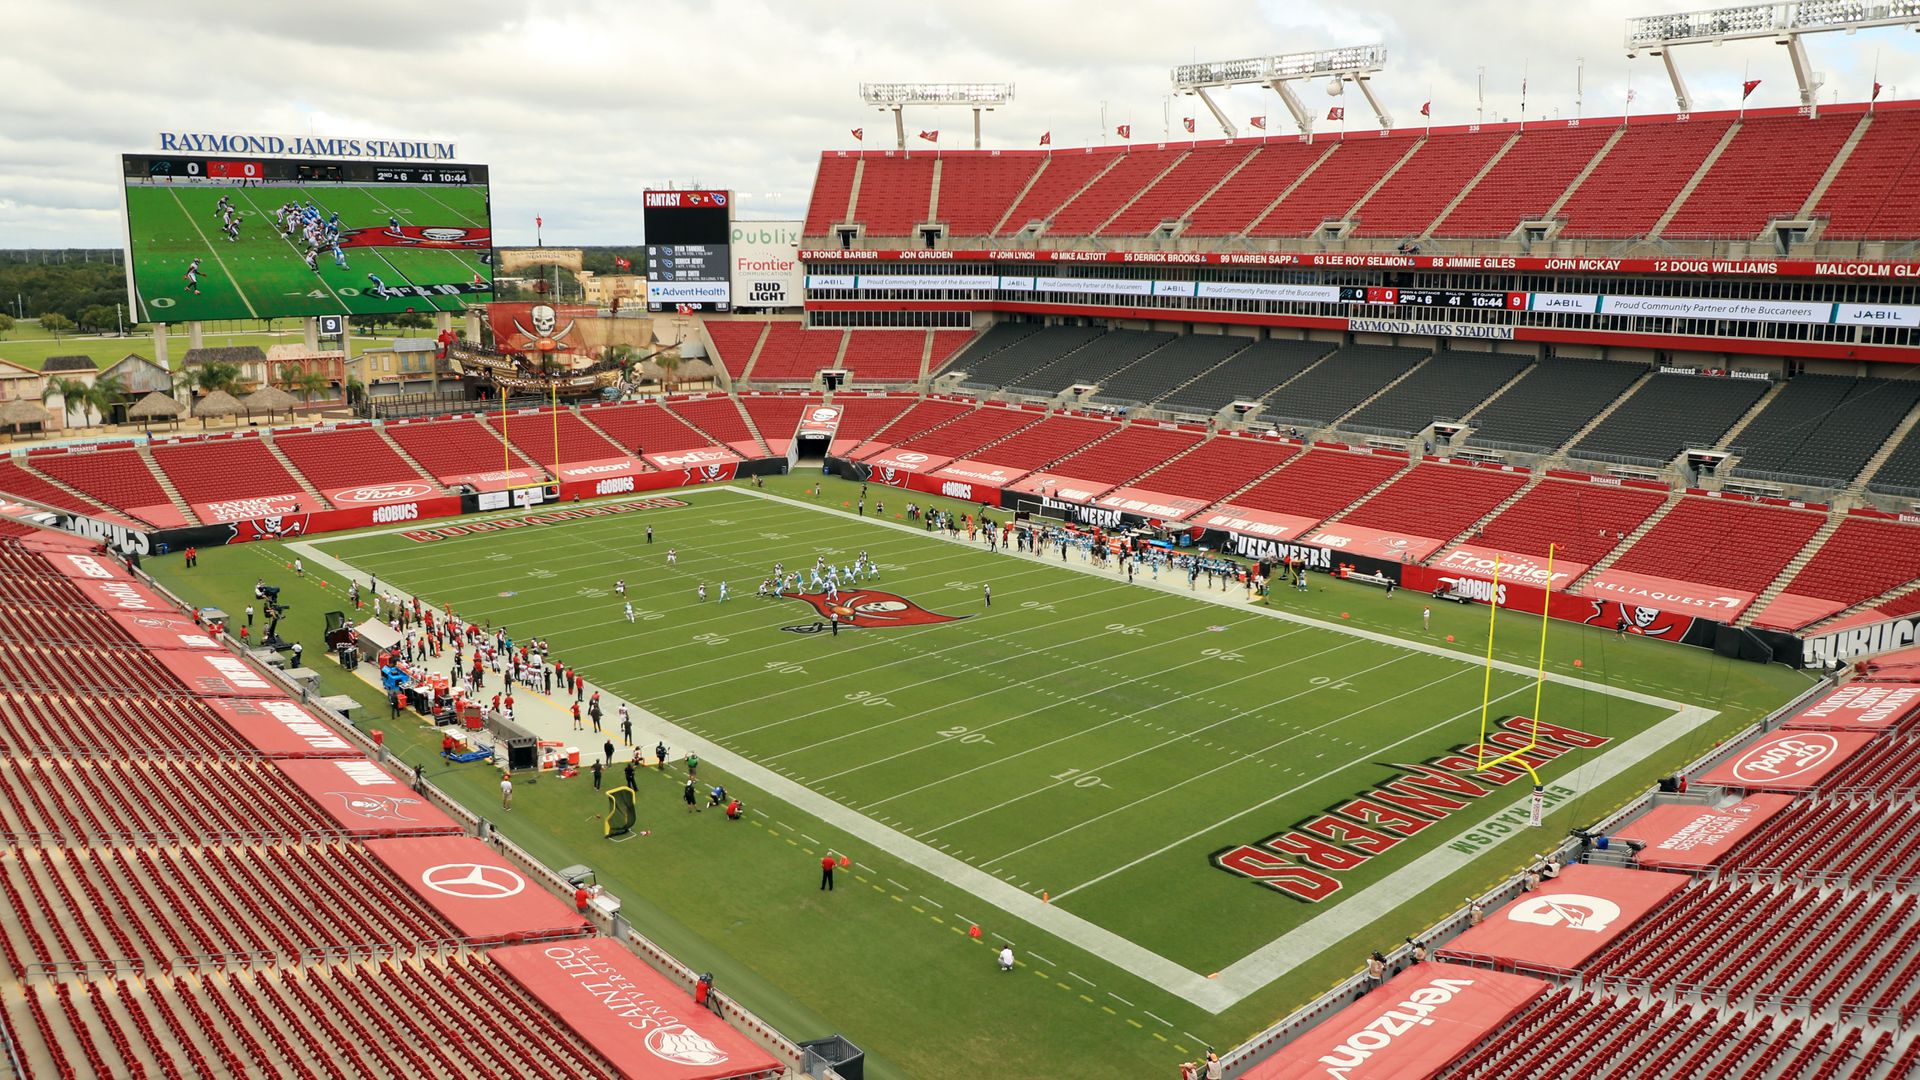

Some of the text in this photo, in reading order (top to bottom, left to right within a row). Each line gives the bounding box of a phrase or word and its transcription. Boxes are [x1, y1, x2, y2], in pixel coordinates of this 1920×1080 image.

[160, 132, 455, 160] RAYMOND JAMES STADIUM
[187, 162, 199, 175] 0
[244, 164, 256, 176] 0
[378, 172, 392, 180] 2ND
[400, 173, 408, 181] 6
[422, 174, 432, 182] 41
[439, 174, 468, 182] 10:44
[646, 193, 682, 206] FANTASY
[731, 228, 797, 245] Publix
[813, 250, 842, 259] RONDÉ
[1015, 252, 1036, 260] LYNCH
[1059, 252, 1078, 260] MIKE
[1078, 252, 1107, 262] ALSTOTT
[1124, 253, 1200, 262] 55 DERRICK BROOKS
[1220, 254, 1292, 264] 99 WARREN SAPP
[1314, 256, 1407, 266] 63 LEE ROY SELMON
[738, 258, 794, 270] Frontier
[1432, 258, 1516, 268] 88 JIMMIE GILES
[1545, 260, 1620, 272] JOHN MCKAY
[1654, 262, 1778, 274] 12 DOUG WILLIAMS
[1815, 264, 1890, 276] MALCOLM
[434, 284, 460, 295] 10
[754, 282, 780, 292] BUD
[884, 279, 913, 288] Community
[1055, 281, 1082, 289] Community
[662, 288, 726, 296] AdventHealth
[750, 292, 786, 301] LIGHT
[1222, 286, 1254, 296] Community
[1355, 289, 1363, 298] 0
[1385, 290, 1392, 300] 0
[1400, 295, 1416, 303] 2ND
[1425, 296, 1432, 304] 6
[1449, 296, 1460, 305] 41
[1472, 297, 1504, 307] 10:44
[1512, 297, 1520, 306] 9
[1546, 300, 1582, 308] JABIL
[1614, 301, 1812, 316] Proud Community Partner of the Buccaneers
[1854, 310, 1902, 320] JABIL
[326, 319, 336, 330] 9
[1350, 320, 1512, 339] RAYMOND JAMES STADIUM
[1660, 366, 1696, 375] BUCCANEERS
[1731, 370, 1768, 380] BUCCANEERS
[653, 452, 731, 466] FedEx
[564, 462, 630, 476] verizon
[942, 468, 1008, 482] AdventHealth
[596, 476, 634, 495] #GOBUCS
[1591, 476, 1620, 486] BUCCANEERS
[354, 486, 416, 500] Ford
[942, 480, 972, 500] #GOBUCS
[208, 494, 296, 510] RAYMOND
[214, 502, 271, 516] JAMES
[1102, 496, 1124, 506] ALL
[1124, 500, 1148, 510] OUR
[216, 504, 296, 522] STADIUM
[372, 503, 418, 523] #GOBUCS
[400, 497, 689, 543] BUCCANEERS
[1208, 516, 1288, 536] ON THE FRONT
[1310, 534, 1352, 548] LINES
[1444, 550, 1568, 581] Frontier
[1440, 561, 1550, 586] COMMUNICATIONS
[1594, 582, 1719, 608] RELIAQUEST
[692, 632, 730, 646] 50
[766, 660, 802, 674] 40
[844, 690, 889, 707] 30
[1802, 686, 1867, 717] STADIUM
[1846, 688, 1894, 708] JAMES
[1857, 688, 1920, 722] RAYMOND
[936, 726, 986, 745] 20
[1745, 740, 1826, 774] Ford
[1050, 768, 1102, 789] 10
[1212, 714, 1615, 902] BUCCANEERS
[1448, 807, 1534, 855] RACISM
[1657, 814, 1716, 850] FOUNDATION
[1675, 816, 1732, 851] BUCCANEERS
[1701, 817, 1748, 846] TAMPA BAY
[545, 947, 662, 1030] SAINT LEO
[574, 946, 678, 1025] UNIVERSITY
[1318, 978, 1475, 1078] verizon
